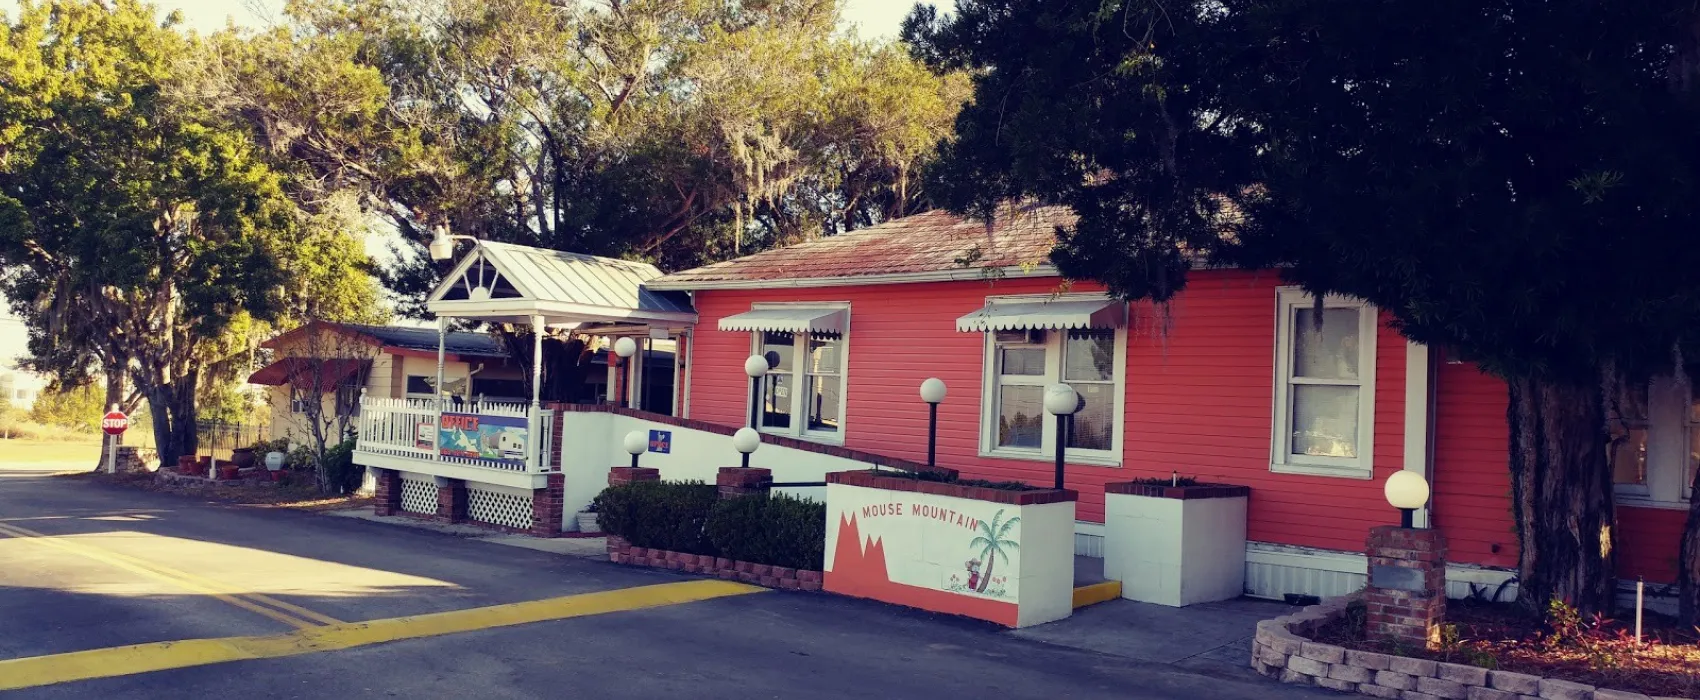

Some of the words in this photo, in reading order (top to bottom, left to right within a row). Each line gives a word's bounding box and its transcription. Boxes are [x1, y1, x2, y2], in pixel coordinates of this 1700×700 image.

[103, 418, 127, 428] STOP
[441, 415, 479, 431] OFFICE
[862, 503, 903, 519] MOUSE
[912, 503, 979, 532] MOUNTAIN
